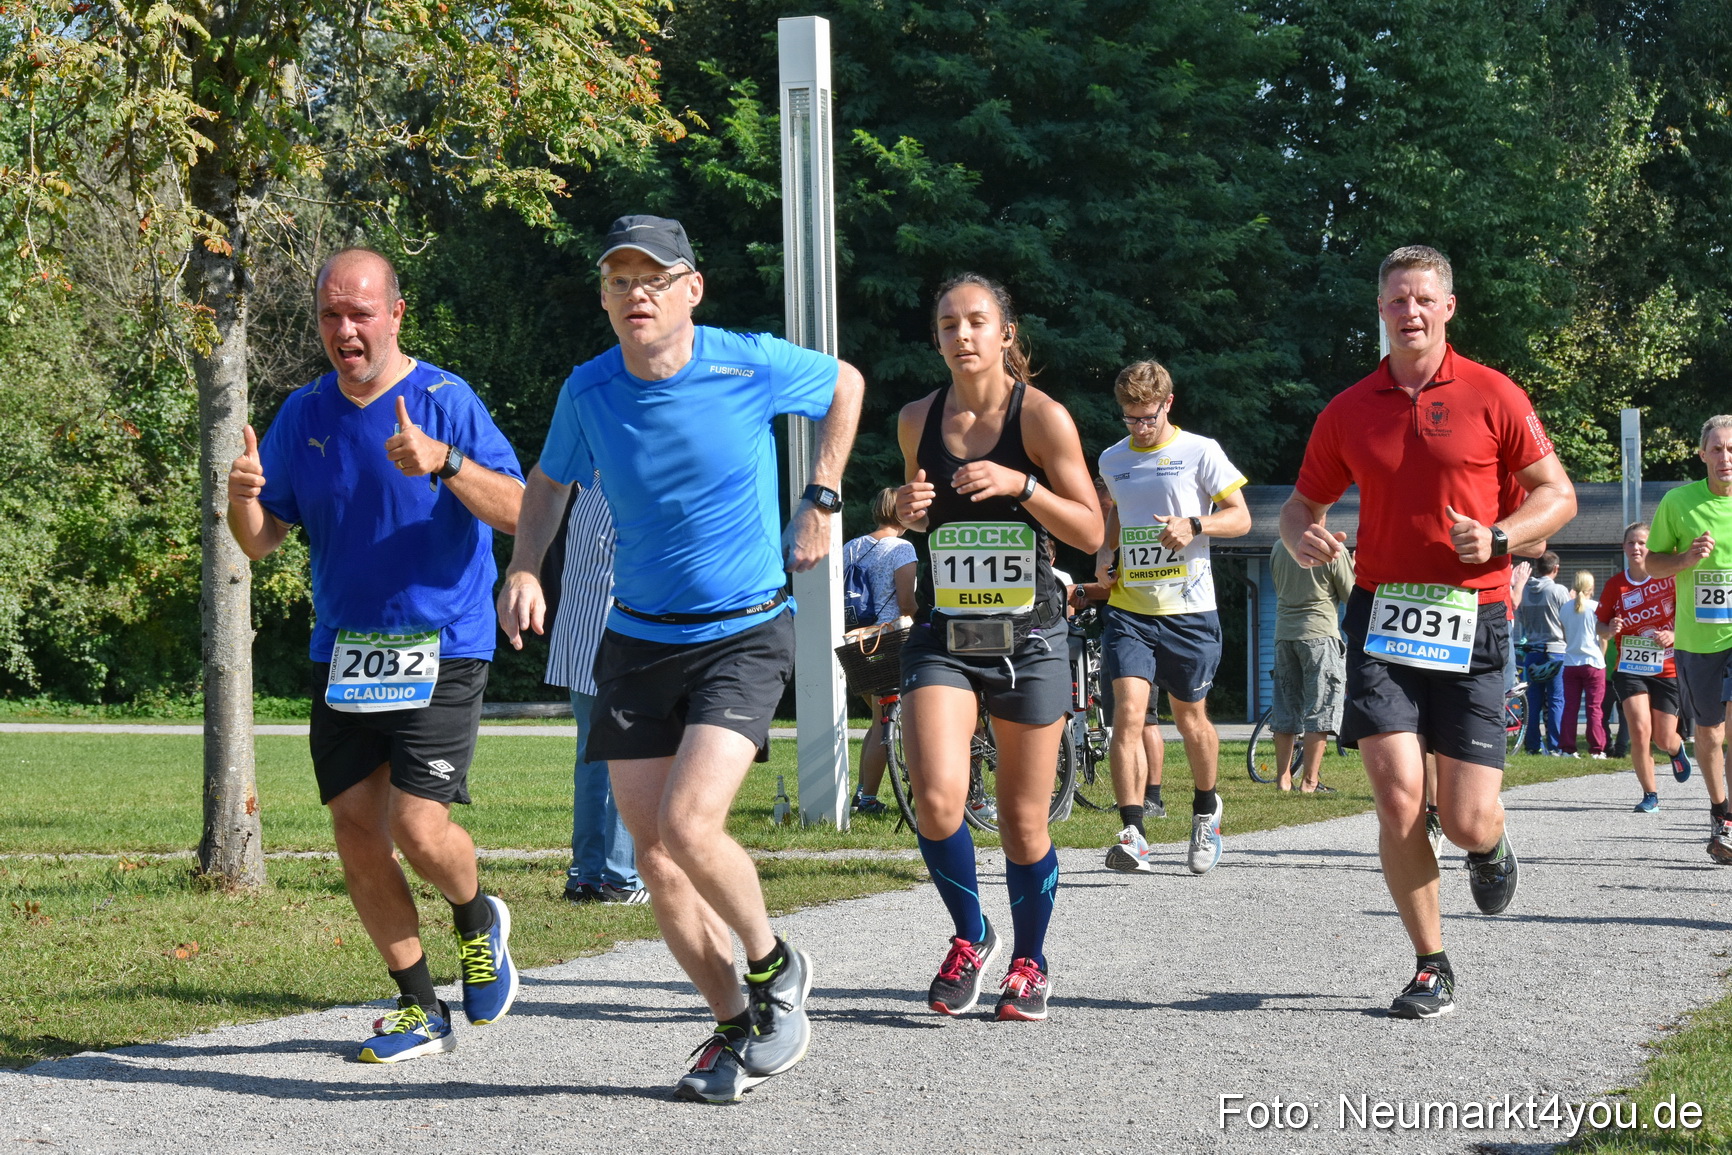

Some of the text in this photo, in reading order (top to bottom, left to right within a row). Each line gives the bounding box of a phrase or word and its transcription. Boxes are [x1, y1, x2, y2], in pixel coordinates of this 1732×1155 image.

[1157, 458, 1170, 466] 20
[938, 527, 1026, 547] BOCK
[944, 556, 1022, 583] 1115
[1129, 568, 1180, 579] CHRISTOPH
[959, 593, 1004, 605] ELISA
[1384, 583, 1467, 608] BOCK
[1381, 604, 1462, 641] 2031
[1385, 640, 1450, 660] ROLAND
[1625, 649, 1658, 663] 2261
[342, 649, 425, 678] 2032
[1626, 663, 1655, 672] CLAUDIA
[343, 686, 416, 700] CLAUDIO
